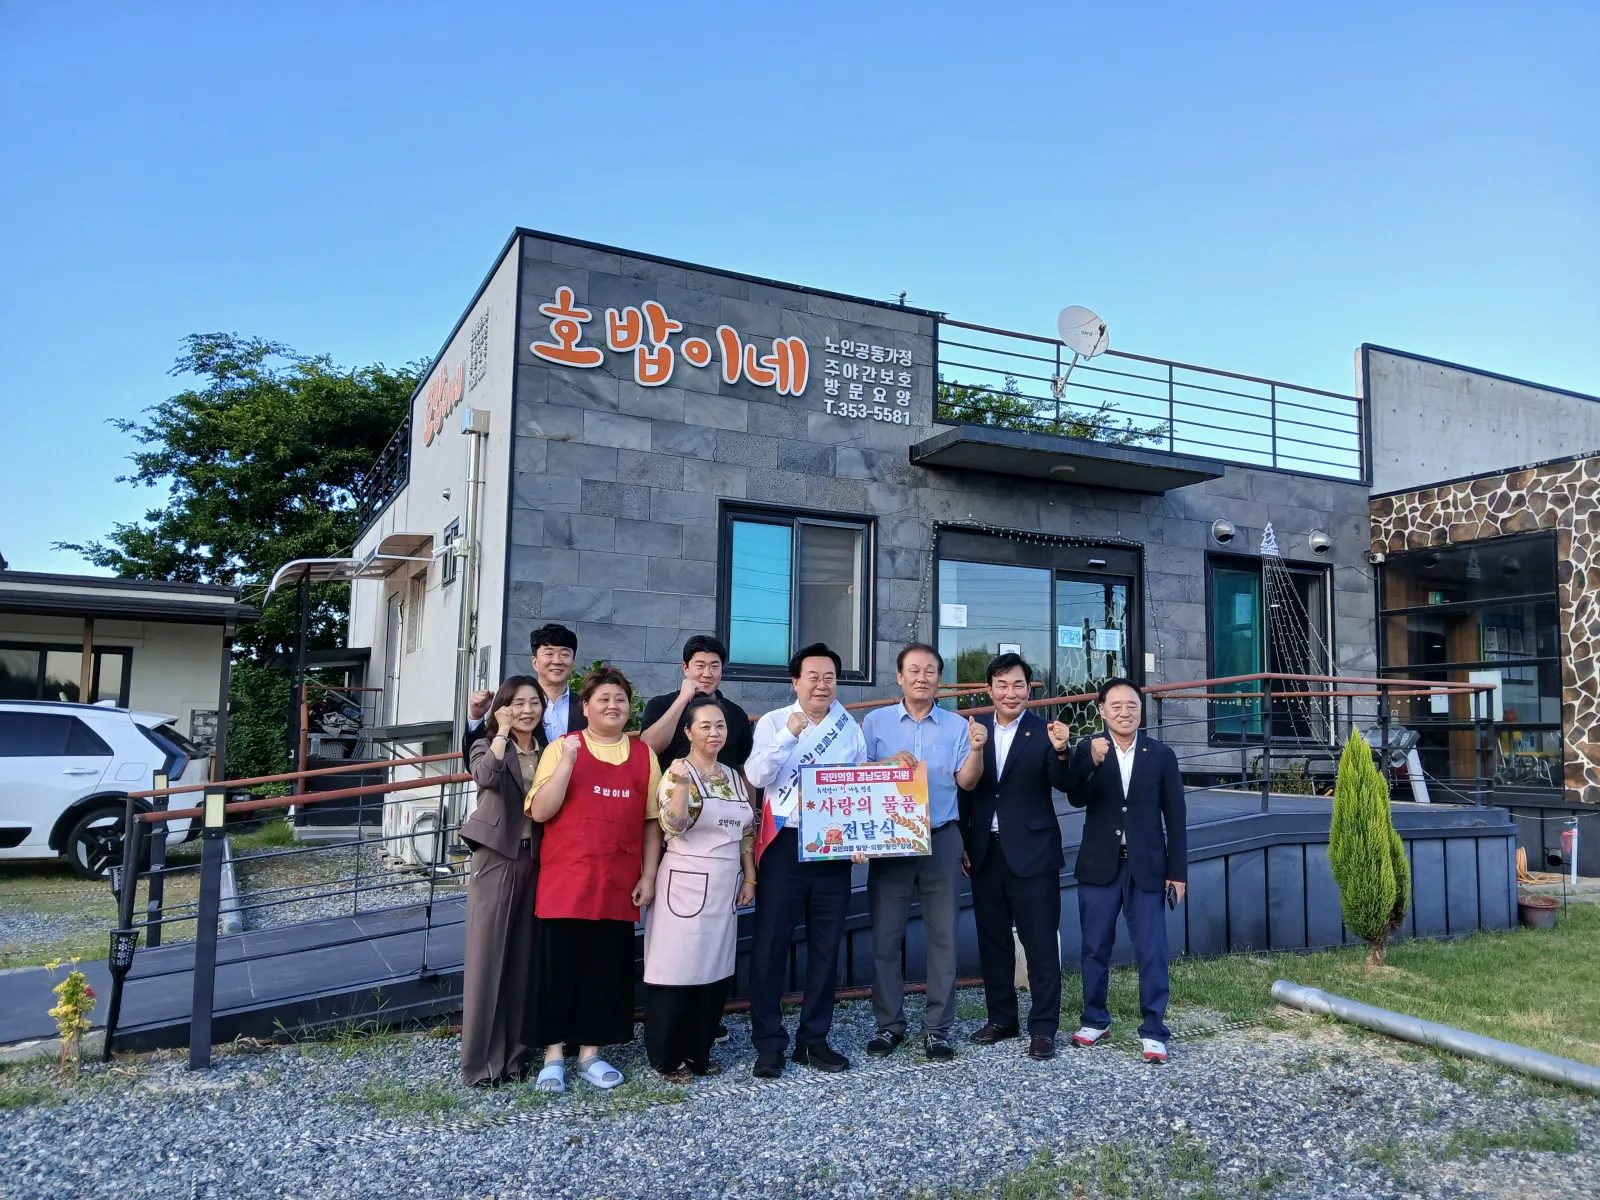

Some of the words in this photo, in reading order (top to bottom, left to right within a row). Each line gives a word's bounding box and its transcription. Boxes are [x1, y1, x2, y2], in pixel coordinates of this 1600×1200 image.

[529, 285, 811, 398] 호밥이네
[825, 336, 912, 367] 노인공동가정
[824, 359, 912, 388] 주야간보호
[824, 399, 910, 425] T.353-5581
[820, 771, 855, 783] 국민의힘
[857, 770, 891, 782] 경남도당
[892, 770, 910, 780] 지원
[593, 785, 630, 798] 호밥이네
[819, 795, 873, 817] 사랑의
[881, 794, 918, 814] 물품
[842, 819, 896, 841] 전달식
